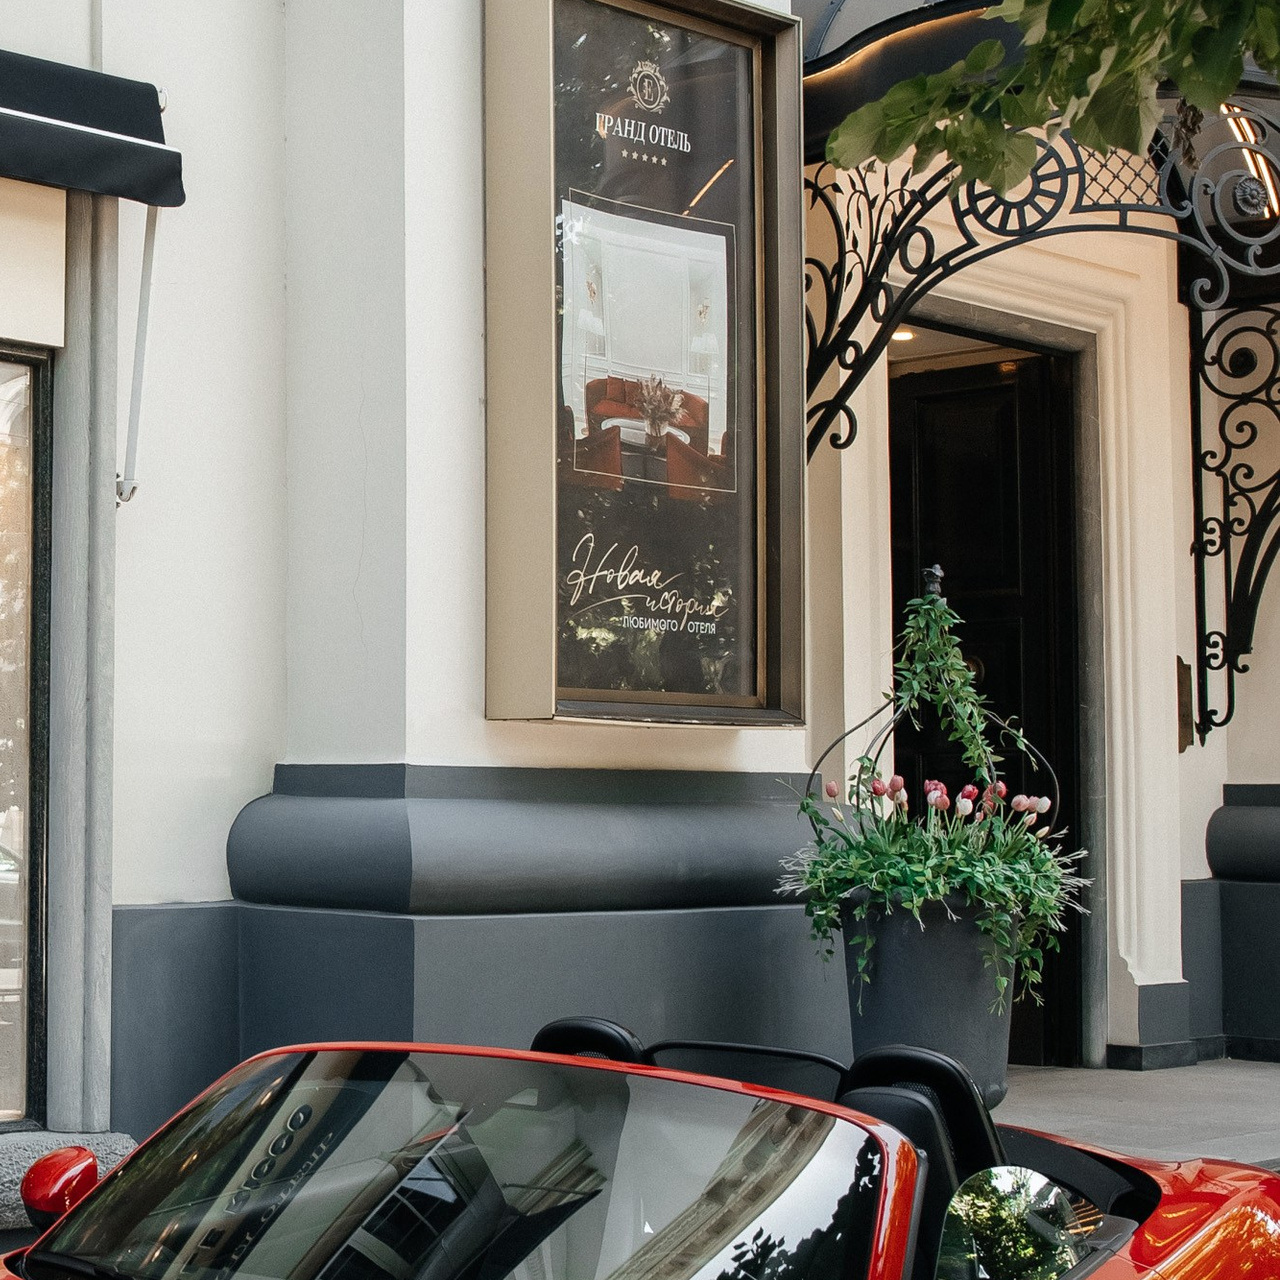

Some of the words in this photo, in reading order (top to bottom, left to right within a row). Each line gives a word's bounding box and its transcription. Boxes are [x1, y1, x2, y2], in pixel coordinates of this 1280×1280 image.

[595, 112, 647, 146] ГРАНД
[648, 124, 692, 153] ОТЕЛЬ
[567, 533, 684, 606] Новая
[622, 615, 679, 632] ЛЮБИМОГО
[687, 621, 716, 635] ОТЕЛЯ
